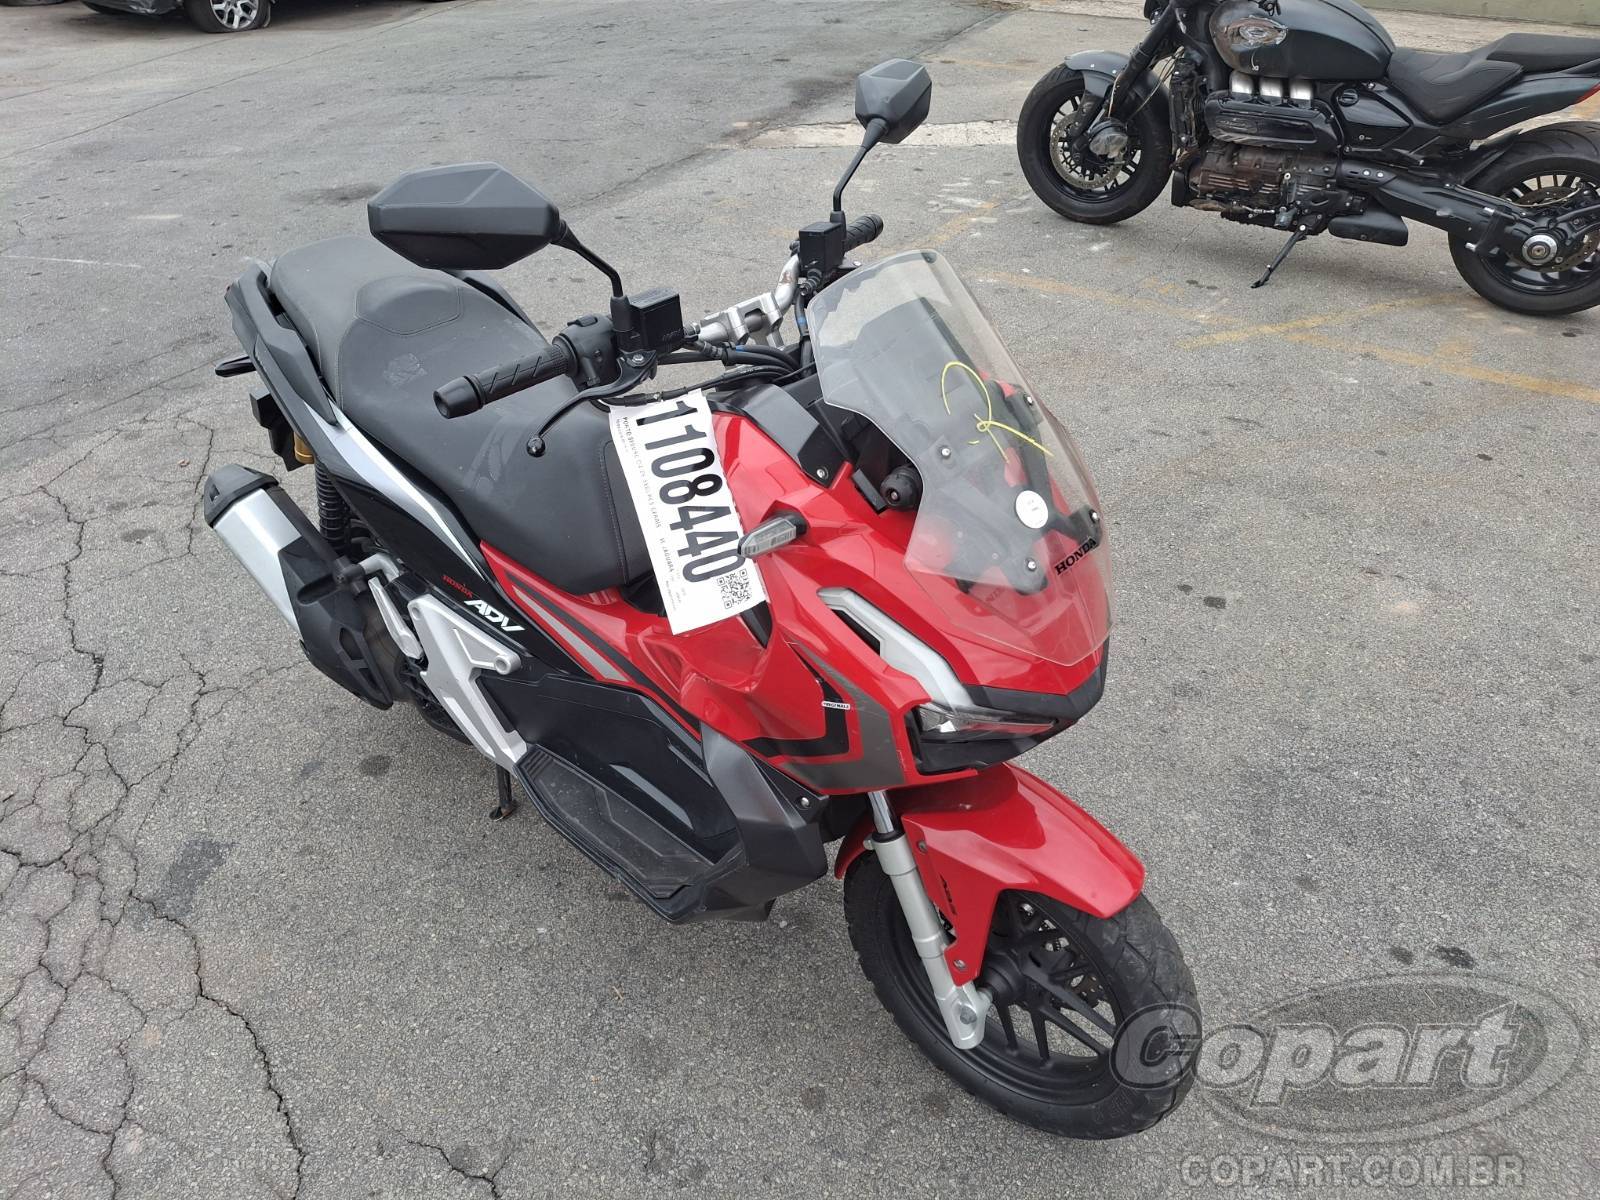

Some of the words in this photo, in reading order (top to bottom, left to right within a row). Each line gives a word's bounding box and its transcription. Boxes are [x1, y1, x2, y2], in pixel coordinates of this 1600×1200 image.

[636, 400, 746, 583] 1108440
[1055, 538, 1097, 575] HONDA
[463, 600, 525, 632] ADV
